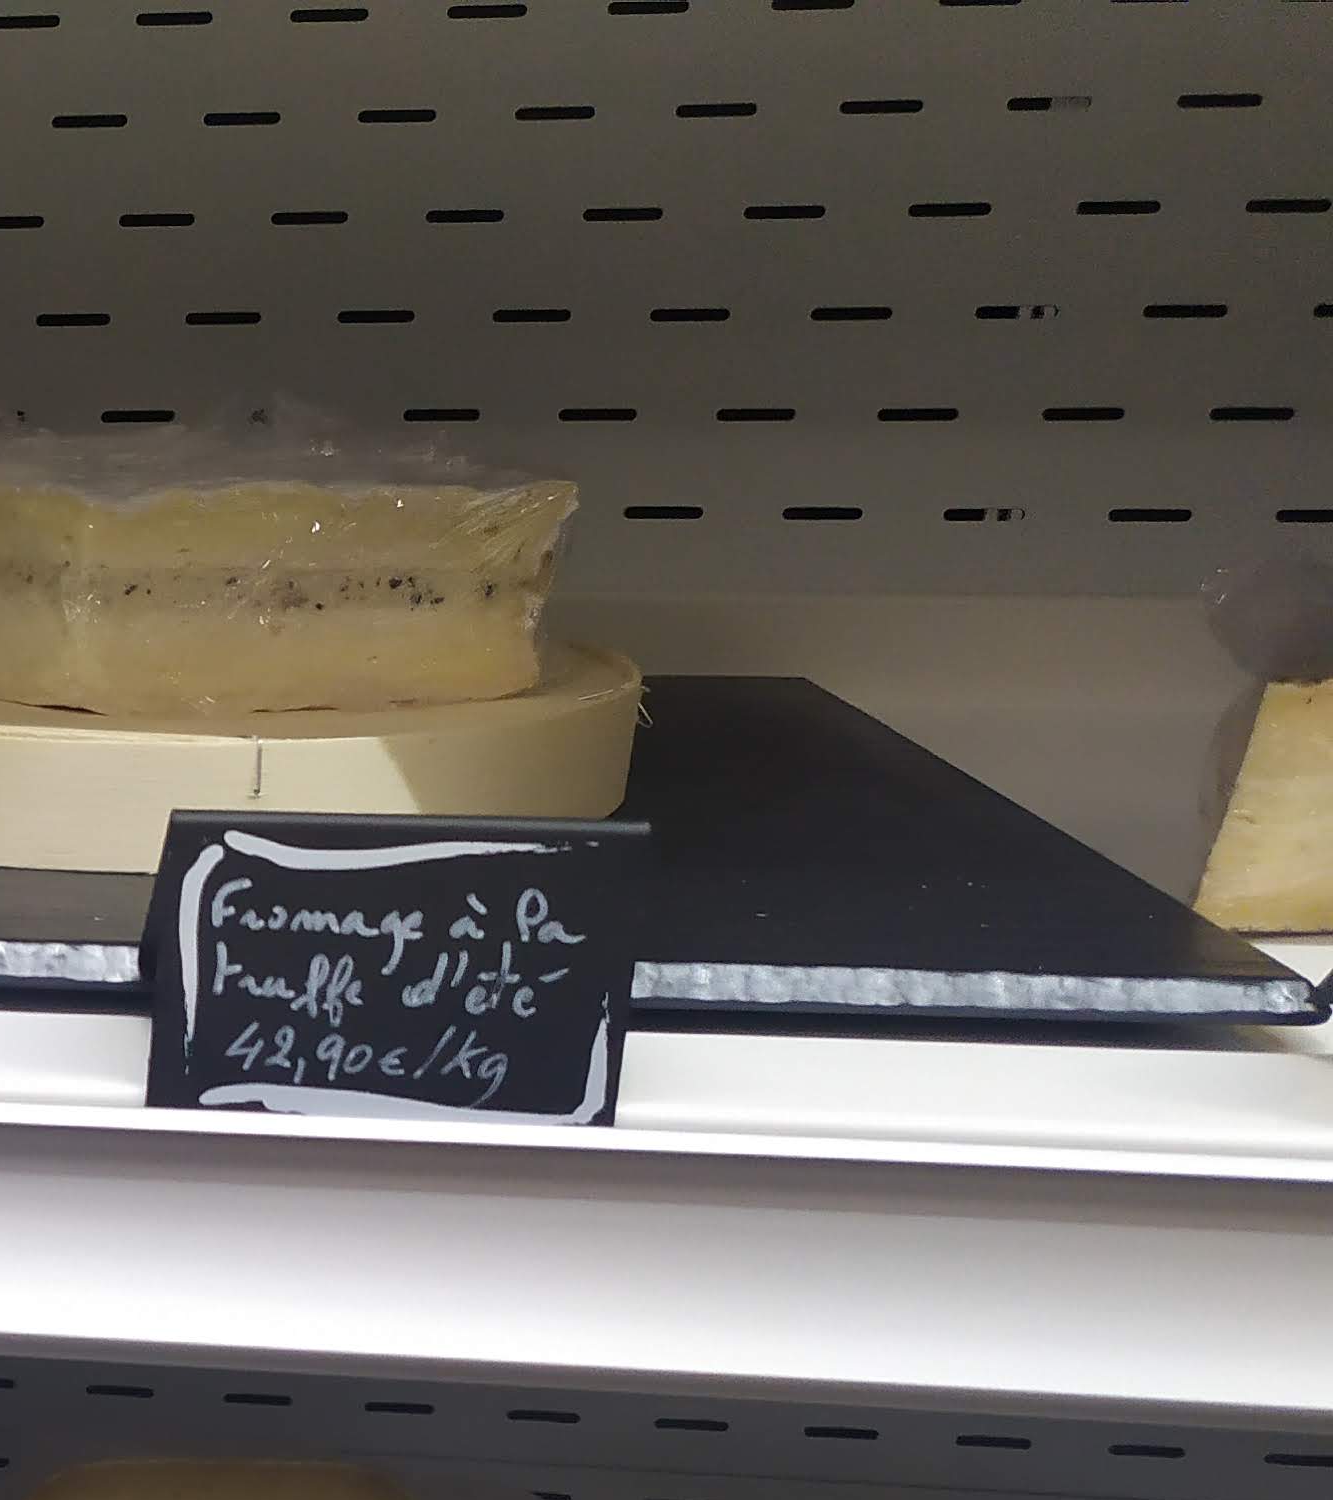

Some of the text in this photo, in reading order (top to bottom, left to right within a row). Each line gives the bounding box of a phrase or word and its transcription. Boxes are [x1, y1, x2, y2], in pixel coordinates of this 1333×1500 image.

[211, 877, 587, 976] Fromage à la
